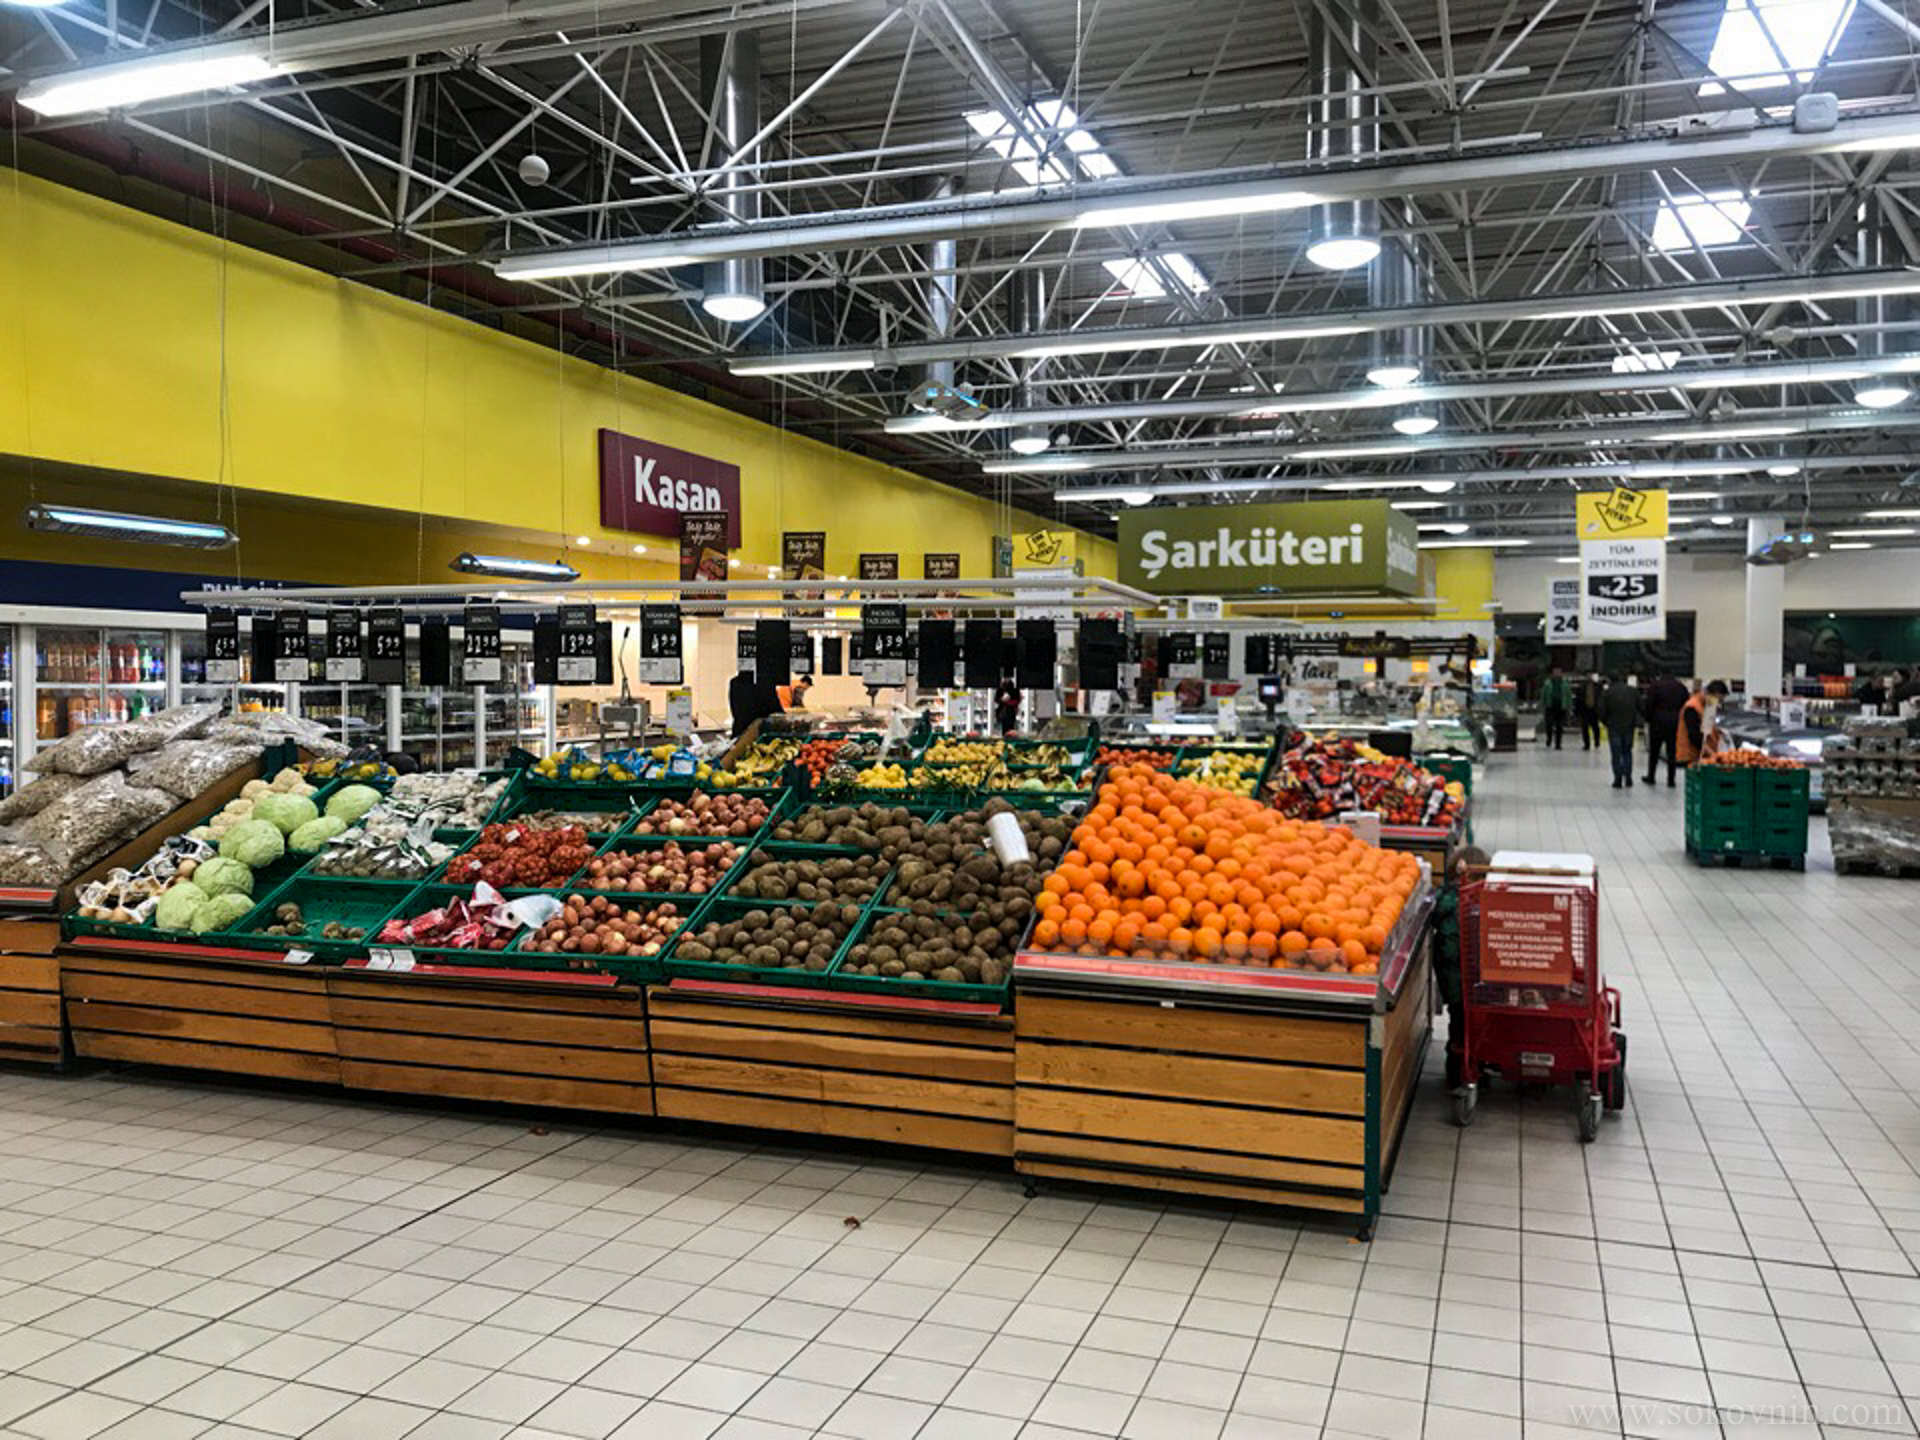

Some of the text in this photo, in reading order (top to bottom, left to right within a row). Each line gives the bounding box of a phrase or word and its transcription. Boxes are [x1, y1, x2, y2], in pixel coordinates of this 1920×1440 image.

[1139, 523, 1364, 579] Şarküteri
[1609, 545, 1635, 555] TÜM
[1588, 559, 1658, 569] ZEYTİNLERDE
[1599, 576, 1645, 596] %25
[1591, 604, 1656, 617] İNDİRİM
[1553, 615, 1579, 632] 24
